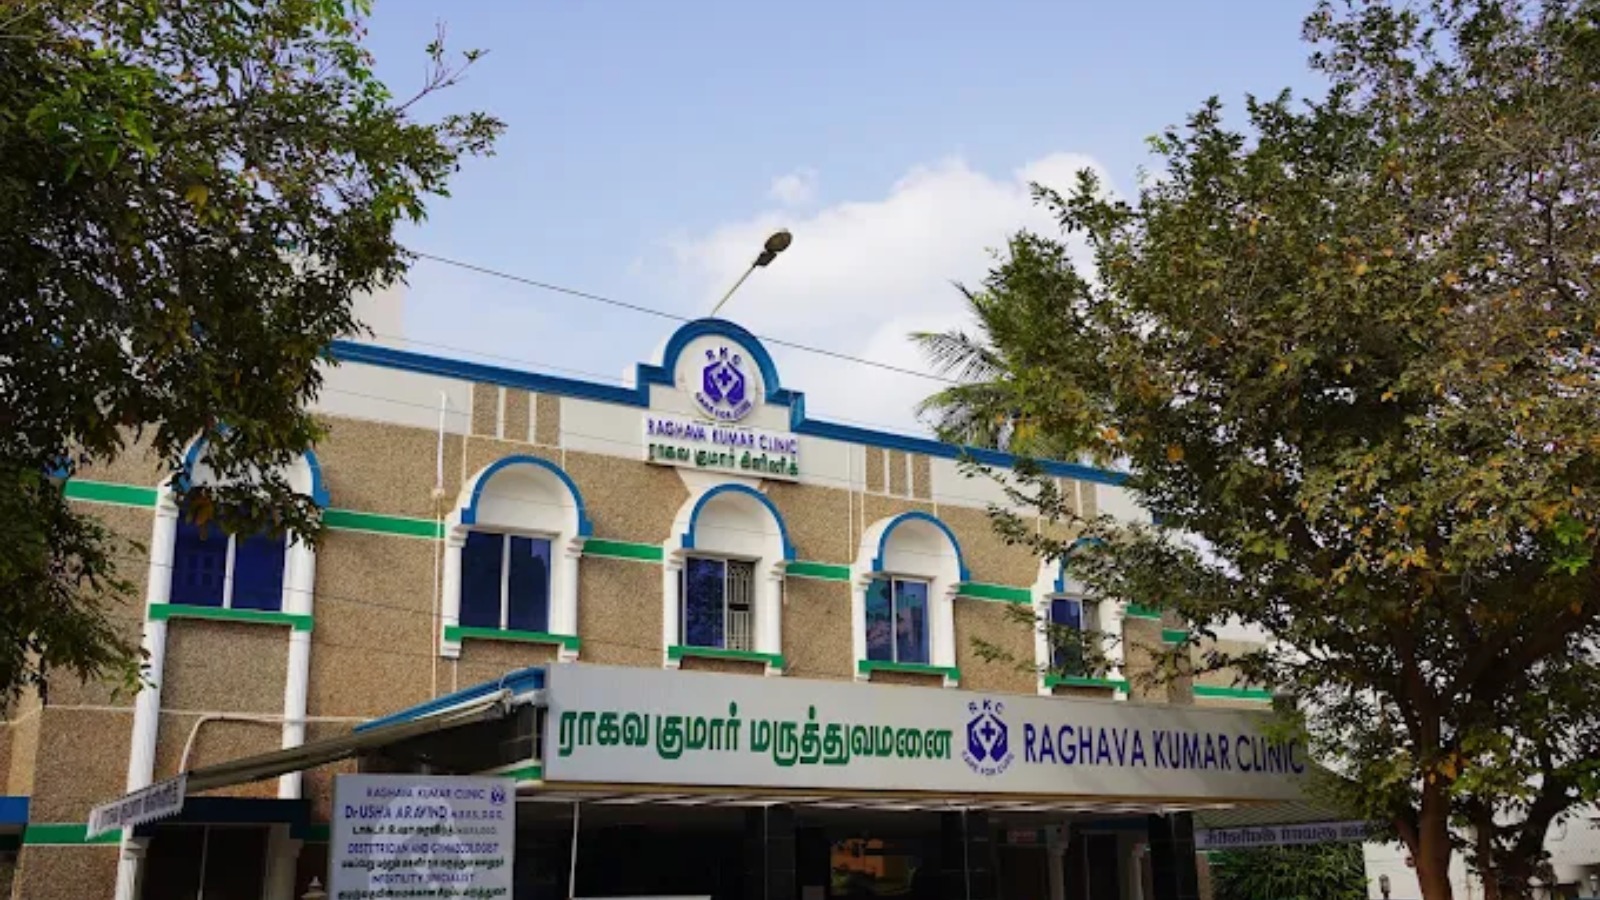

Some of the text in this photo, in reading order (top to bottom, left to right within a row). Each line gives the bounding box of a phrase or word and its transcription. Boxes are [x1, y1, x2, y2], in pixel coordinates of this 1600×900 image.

[647, 418, 798, 455] RAGHAVA KUMAR CLINIC
[649, 443, 690, 461] ராகவ
[694, 447, 735, 467] குமார்
[558, 701, 953, 766] ராகவ குமார் மருத்துவமனை
[1023, 722, 1305, 774] RAGHAVA KUMAR CLINIC
[366, 787, 485, 799] RAGHAVA KUMAR CLINIC
[395, 805, 448, 819] ARAVIND
